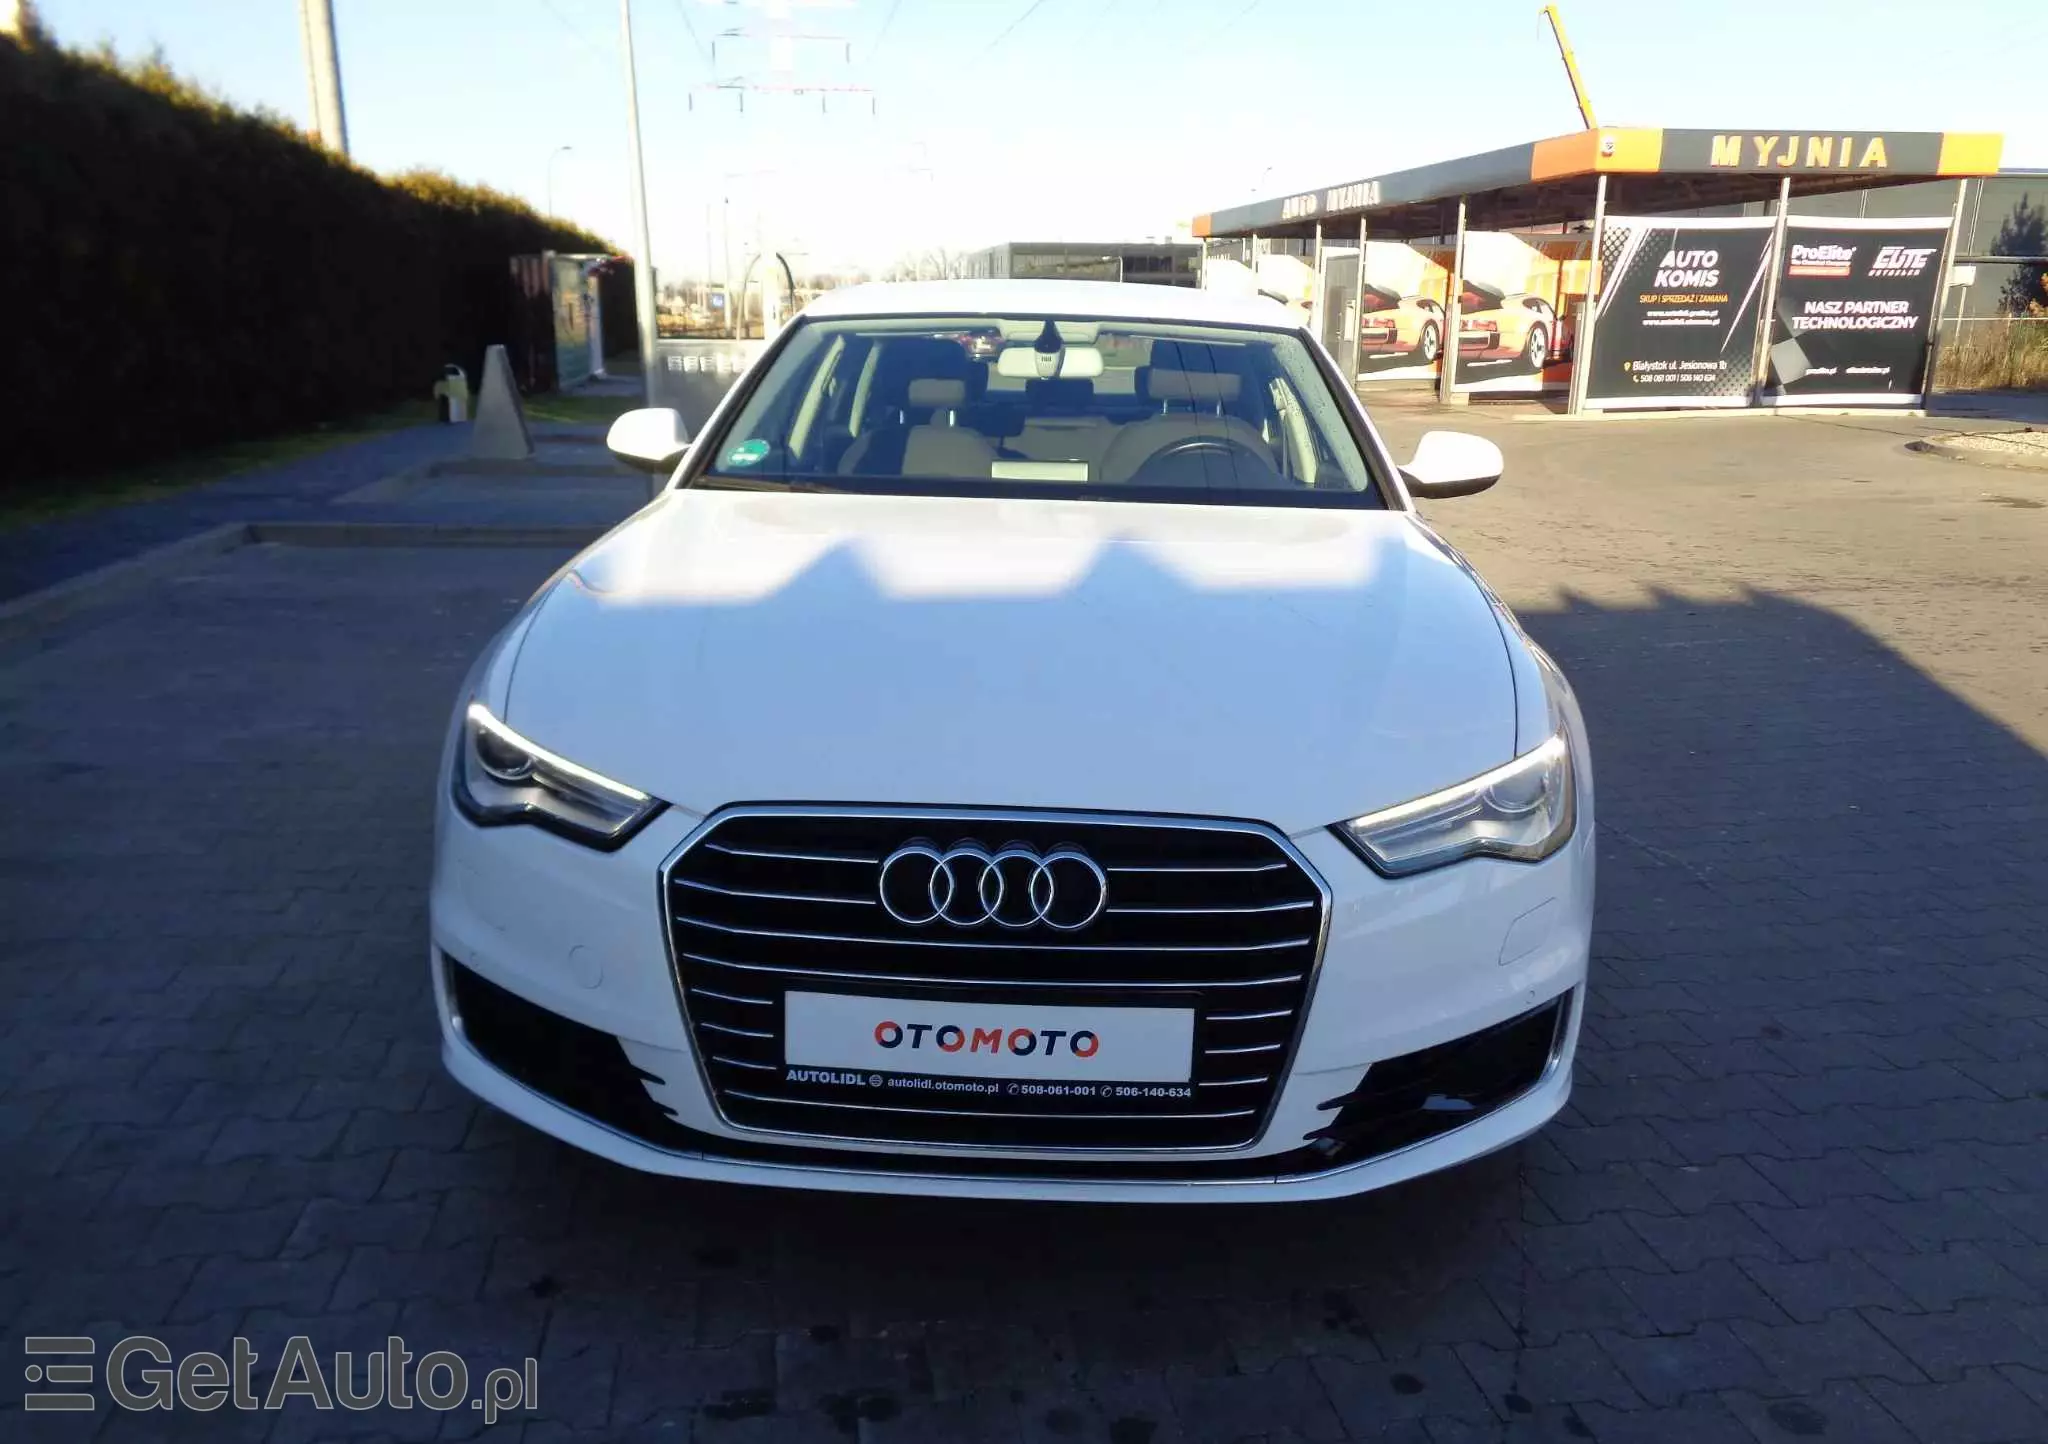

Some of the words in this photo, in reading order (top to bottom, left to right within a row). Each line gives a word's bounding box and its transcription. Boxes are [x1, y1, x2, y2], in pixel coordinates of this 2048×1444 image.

[1710, 135, 1888, 168] MYJNIA
[1282, 194, 1318, 219] AUTO
[1659, 250, 1719, 268] AUTO
[1790, 244, 1854, 260] ProElite
[1654, 269, 1720, 288] KOMIS
[1639, 294, 1658, 303] SKUP
[1698, 294, 1728, 303] ZAMIANA
[1804, 301, 1843, 314] NASZ
[1844, 301, 1910, 314] PARTNER
[1792, 316, 1919, 329] TECHNOLOGICZNY
[1632, 361, 1667, 372] Białystok
[1679, 360, 1717, 370] Jesionowa
[874, 1021, 1100, 1058] OTOMOTO
[786, 1070, 866, 1086] AUTOLIDL
[887, 1077, 999, 1094] autolidl.otomoto.pl
[1021, 1085, 1096, 1096] 508-061-001
[1115, 1086, 1192, 1097] 506-140-634
